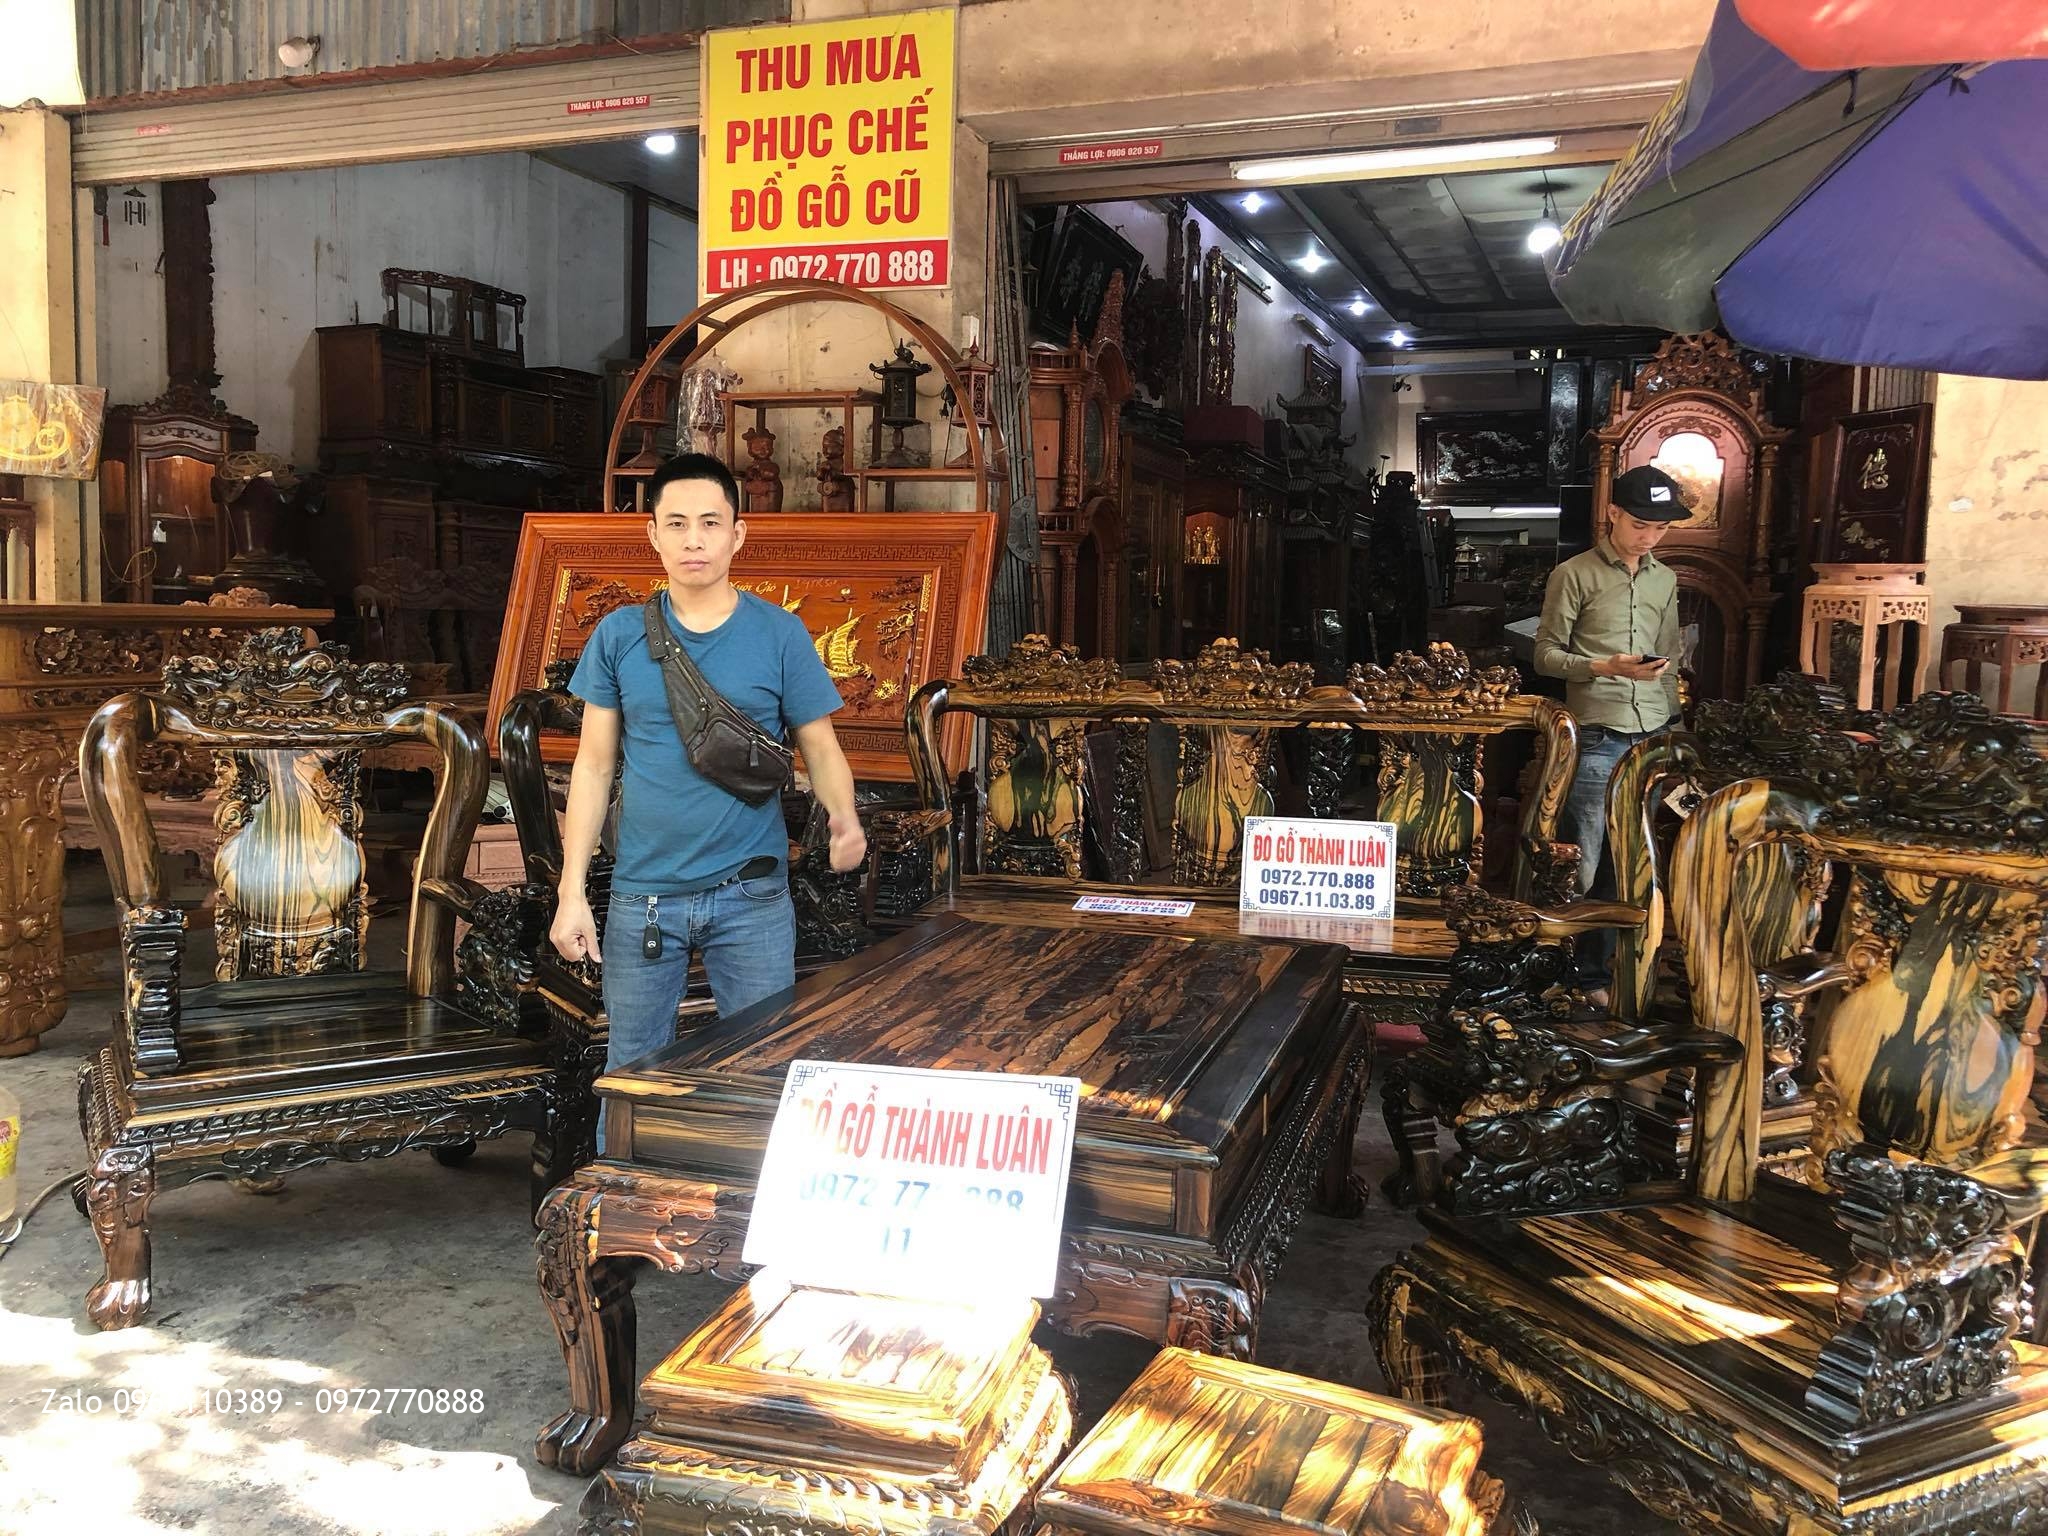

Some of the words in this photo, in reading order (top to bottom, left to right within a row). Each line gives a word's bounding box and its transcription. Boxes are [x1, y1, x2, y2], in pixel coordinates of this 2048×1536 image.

[735, 43, 812, 93] THU
[825, 33, 921, 86] MUA
[726, 112, 833, 170] PHỤC
[848, 87, 934, 155] CHẾ
[1144, 145, 1159, 155] 557
[730, 171, 783, 232] ĐỒ
[797, 164, 850, 229] GỖ
[866, 168, 921, 224] CŨ
[720, 257, 748, 289] LH
[888, 249, 934, 283] 888
[1348, 835, 1386, 868] LUÂN
[1259, 888, 1375, 910] 0967.11.03.89
[1260, 868, 1375, 890] 0972.770.888
[975, 1105, 1053, 1174] LUÂN
